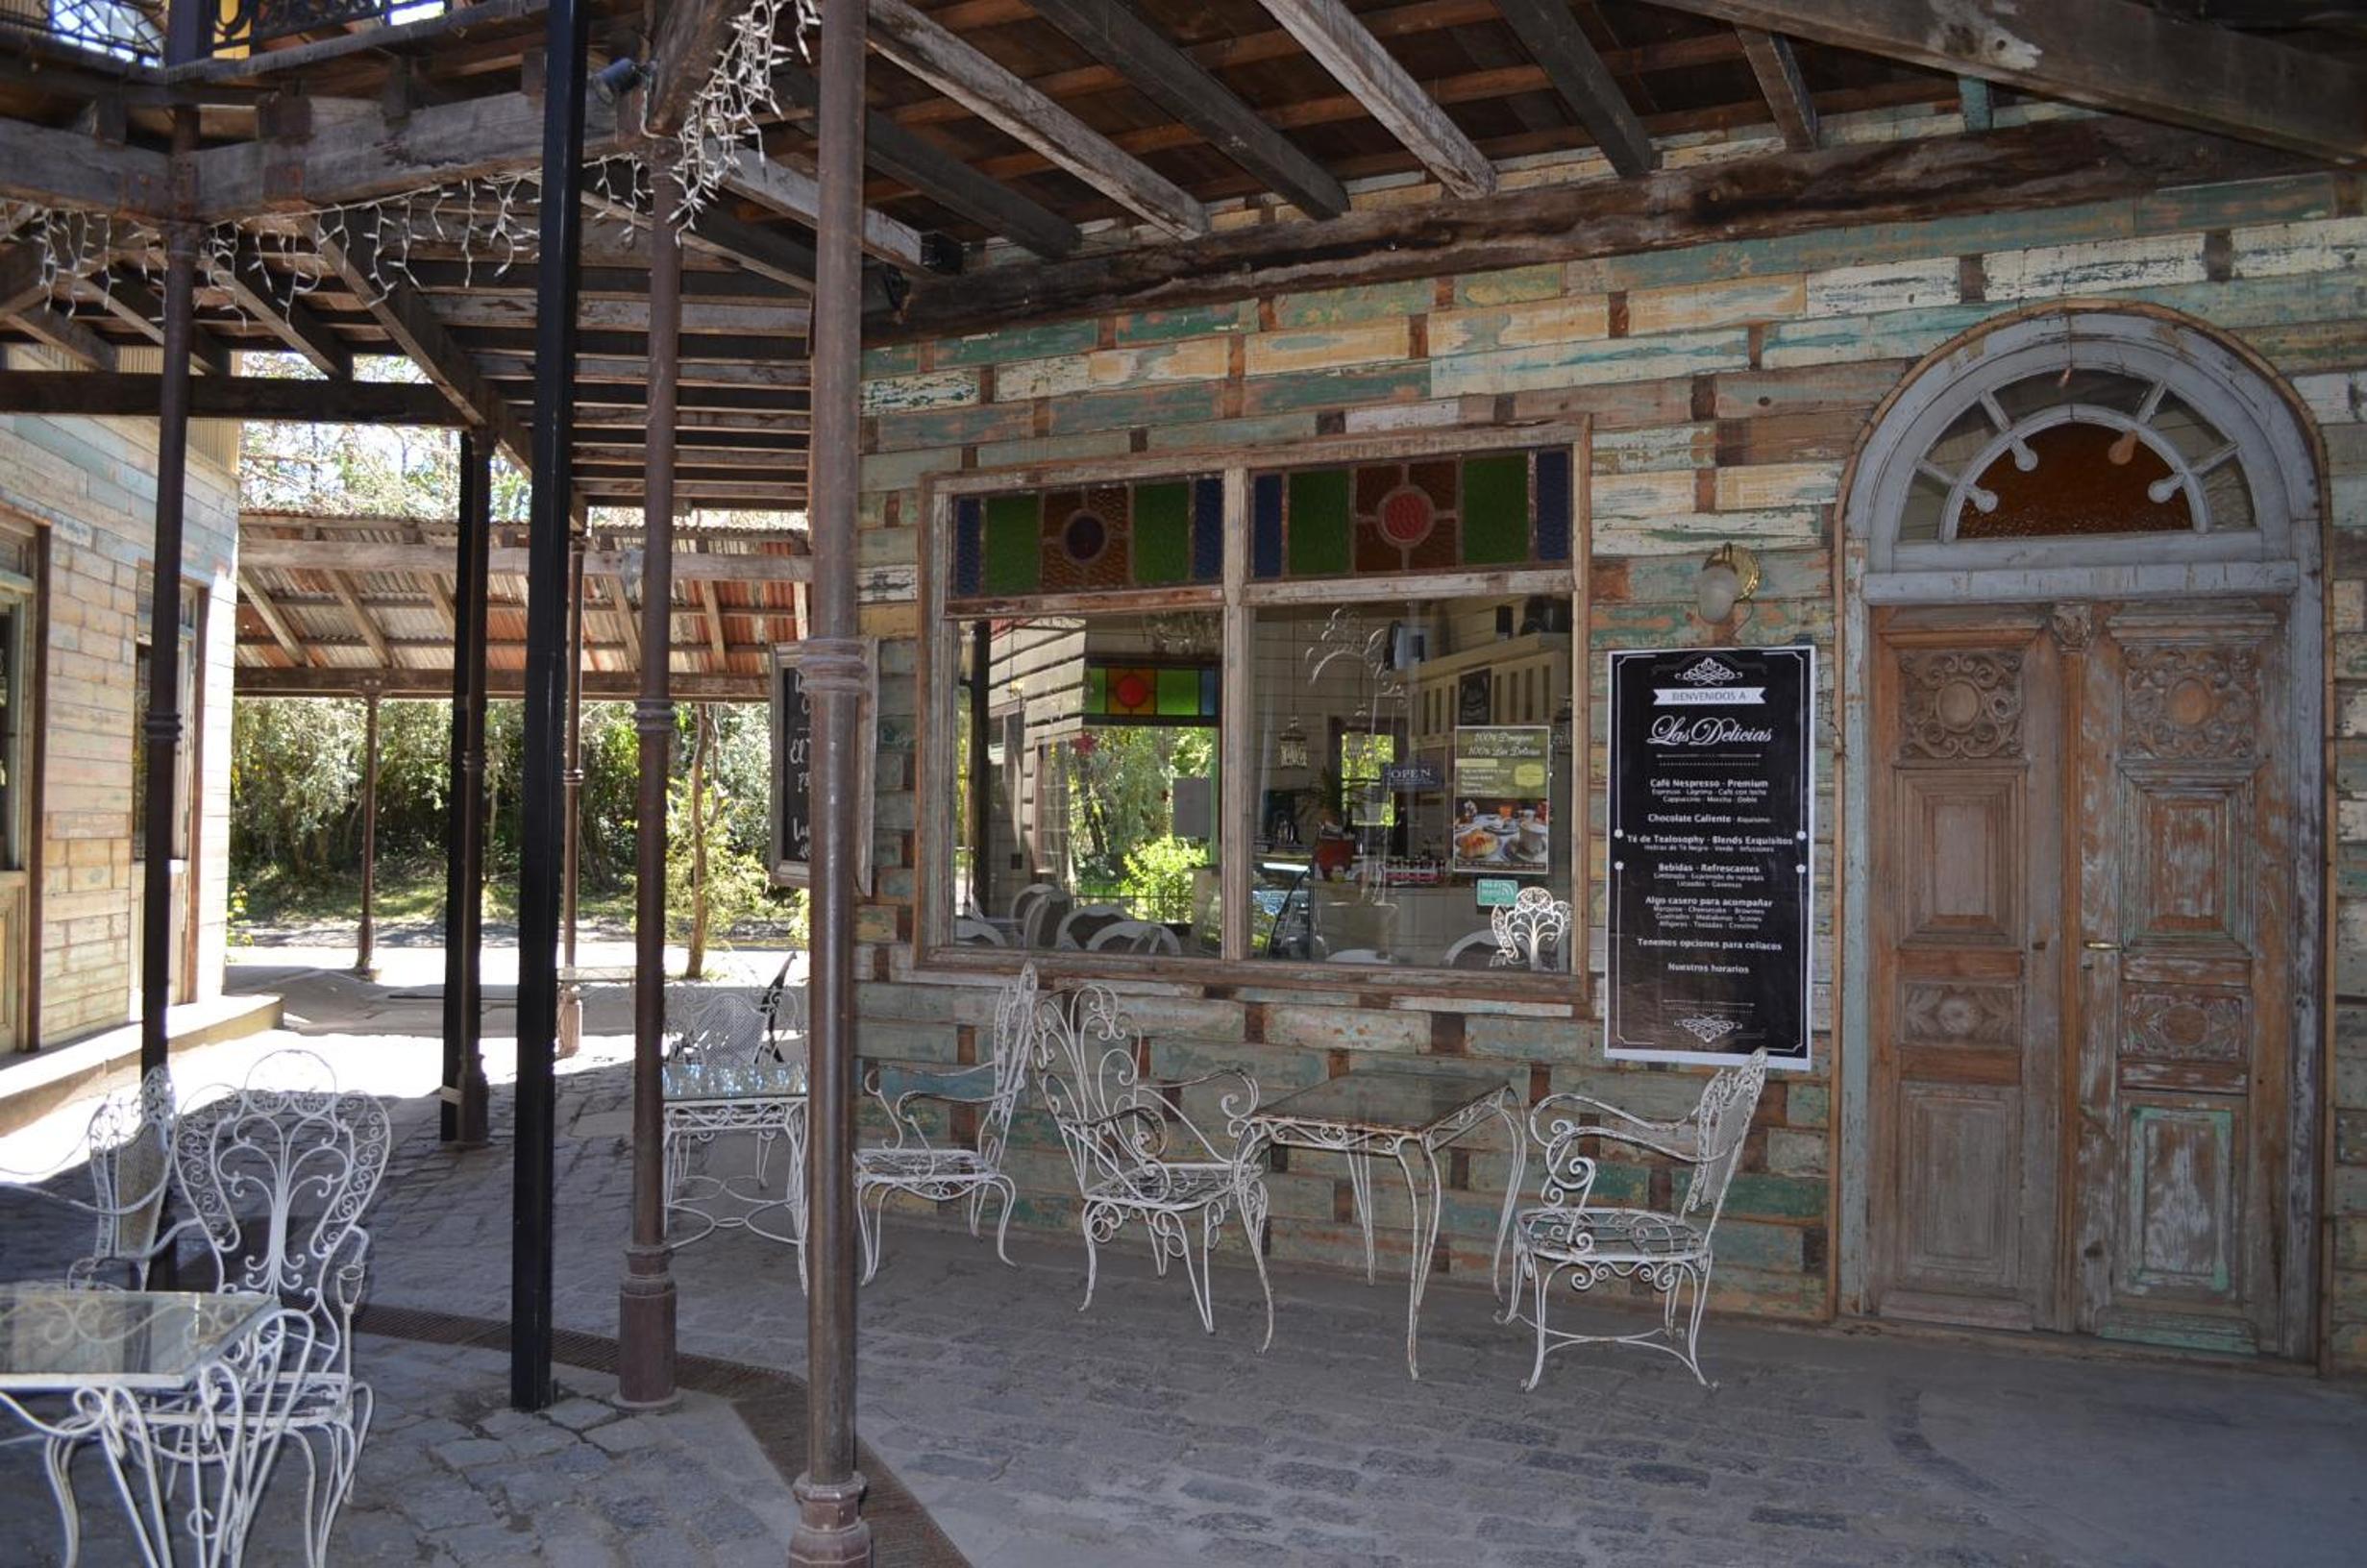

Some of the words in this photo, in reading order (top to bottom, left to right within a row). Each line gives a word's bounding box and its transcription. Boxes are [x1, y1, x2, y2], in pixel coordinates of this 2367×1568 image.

[1672, 691, 1736, 701] BIENVENIDOS
[1738, 691, 1747, 700] A
[1646, 715, 1689, 746] Las
[1689, 717, 1772, 746] Delicias
[1391, 768, 1431, 778] OPEN
[1650, 778, 1670, 788] Café
[1672, 779, 1720, 790] Nespresso
[1727, 778, 1768, 788] Premium
[1647, 813, 1691, 822] Chocolate
[1693, 813, 1733, 823] Caliente
[1640, 834, 1651, 844] de
[1653, 834, 1706, 846] Tealosophy
[1712, 835, 1742, 845] Blends
[1744, 836, 1793, 847] Exquisitos
[1688, 845, 1709, 853] Negro
[1658, 863, 1693, 871] Bebidas
[1700, 863, 1760, 873] Refrescantes
[1645, 895, 1666, 907] Algo
[1667, 897, 1698, 906] casero
[1699, 898, 1720, 908] para
[1722, 898, 1773, 909] acompañar
[1637, 939, 1677, 947] Tenemos
[1679, 940, 1720, 950] opciones
[1722, 941, 1743, 950] para
[1667, 963, 1709, 972] Nuestros
[1711, 964, 1750, 975] horarios
